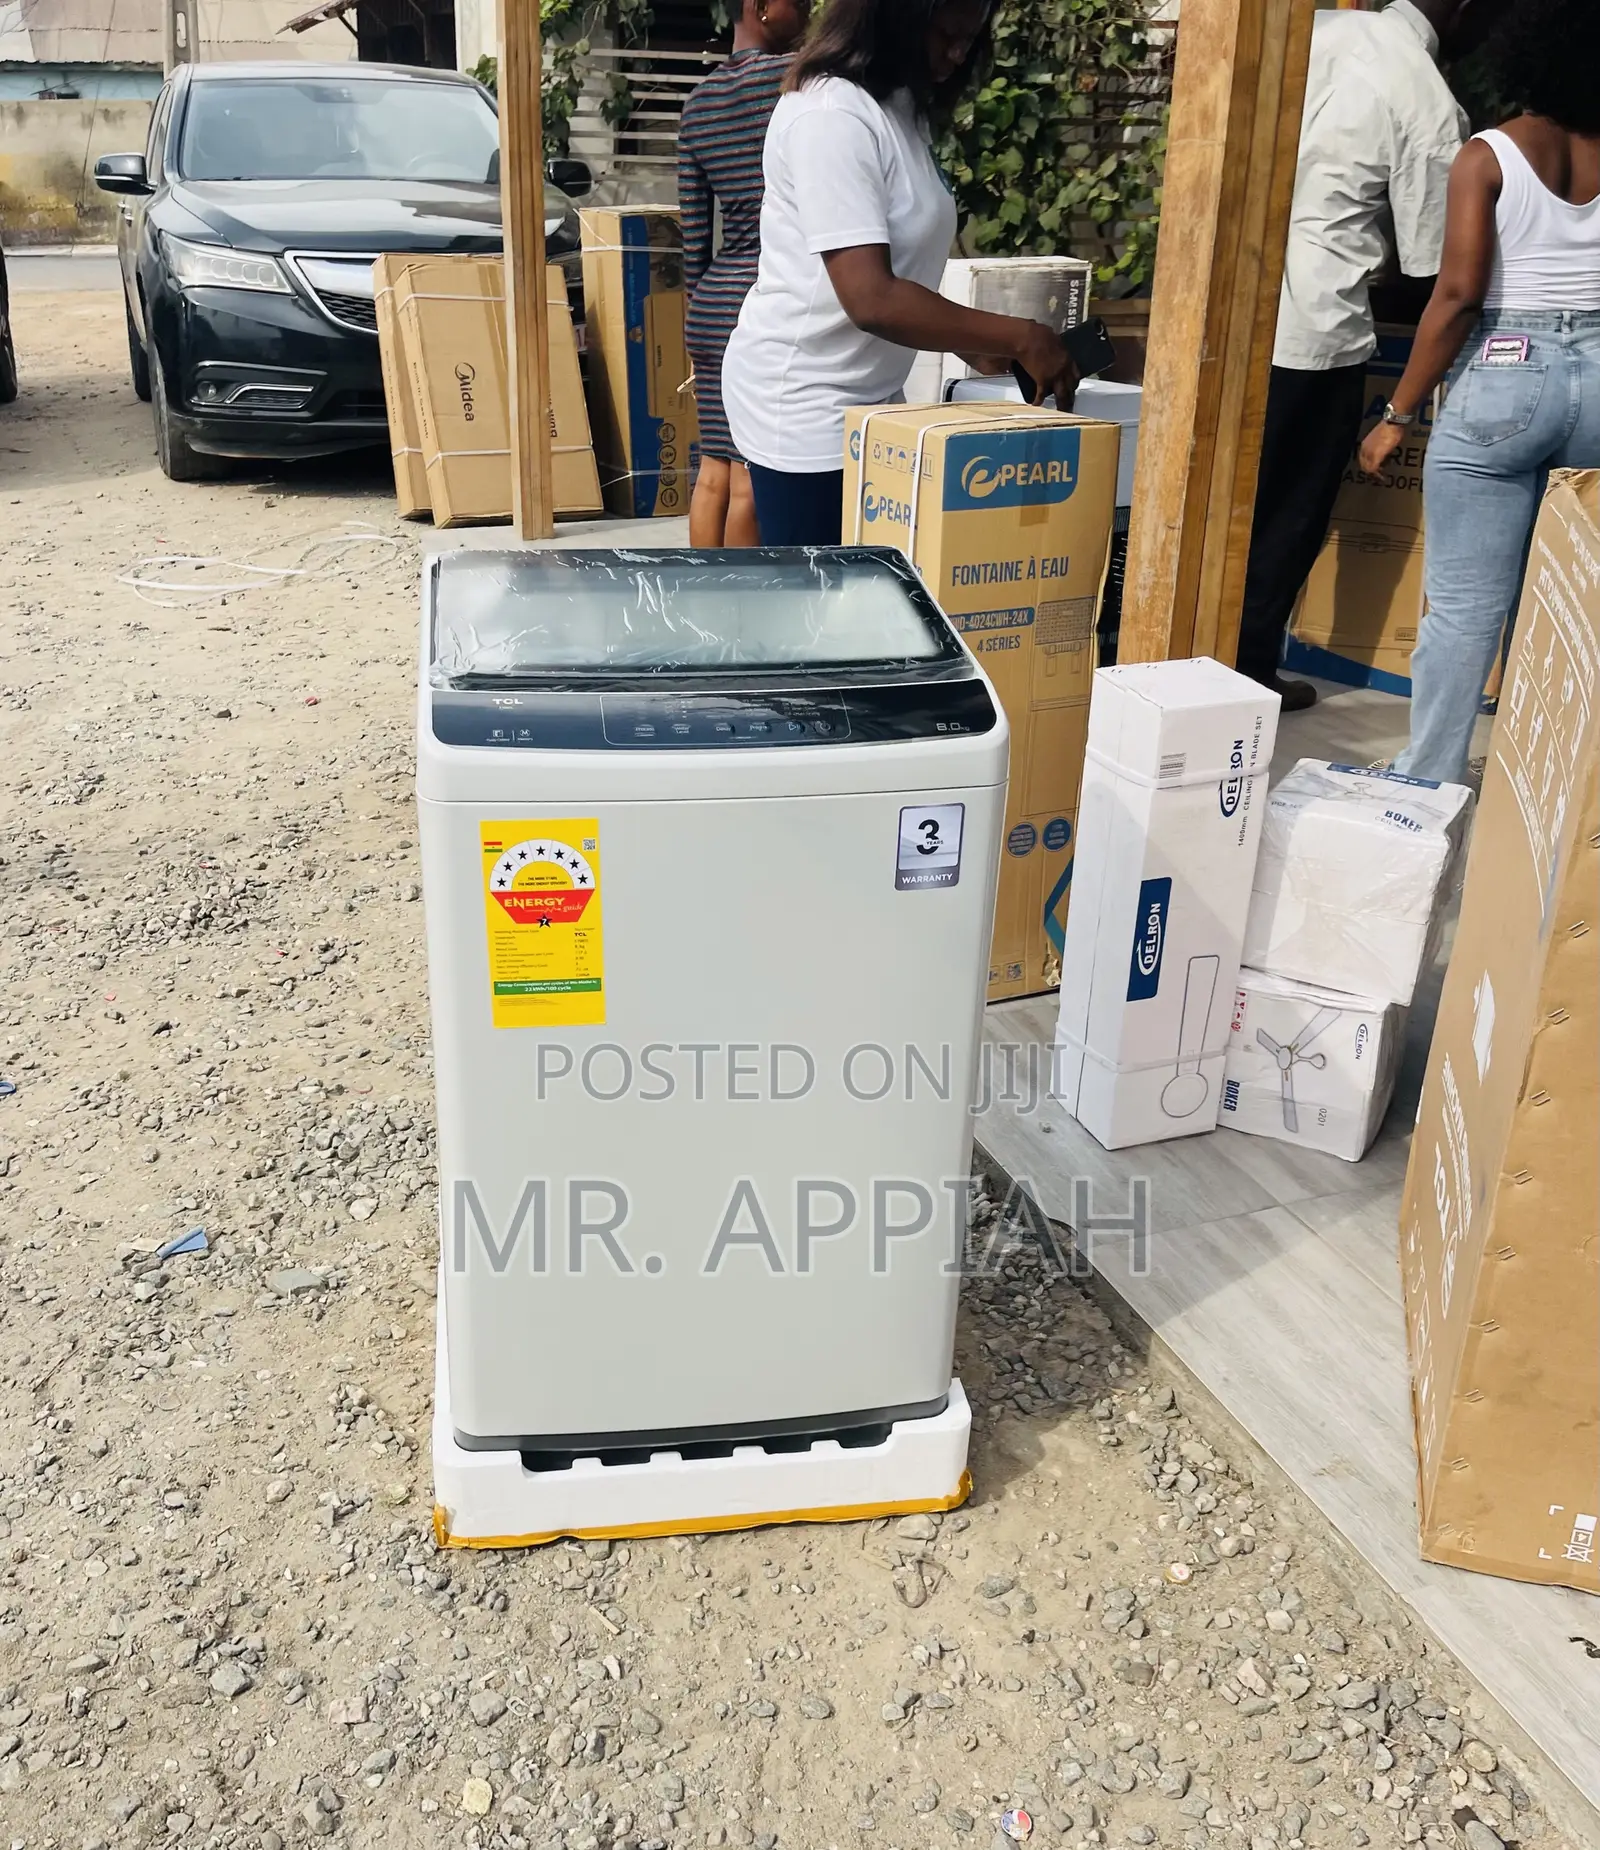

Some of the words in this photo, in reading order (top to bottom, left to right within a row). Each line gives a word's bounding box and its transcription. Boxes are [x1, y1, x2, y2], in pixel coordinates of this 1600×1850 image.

[454, 362, 476, 422] Midea
[952, 561, 1023, 586] FONTAINE
[1026, 556, 1036, 580] À
[1041, 556, 1069, 579] EAU
[976, 639, 984, 652] 4
[1238, 815, 1248, 847] 1400mm
[1250, 733, 1260, 760] BLADE
[1255, 715, 1263, 730] SET
[916, 819, 940, 855] 3
[902, 873, 953, 884] WARRANTY
[504, 896, 565, 910] ENERGY
[562, 902, 584, 912] guide
[1143, 902, 1161, 965] DELRON
[1355, 1028, 1366, 1060] DELRON
[1223, 1080, 1240, 1111] BOXER
